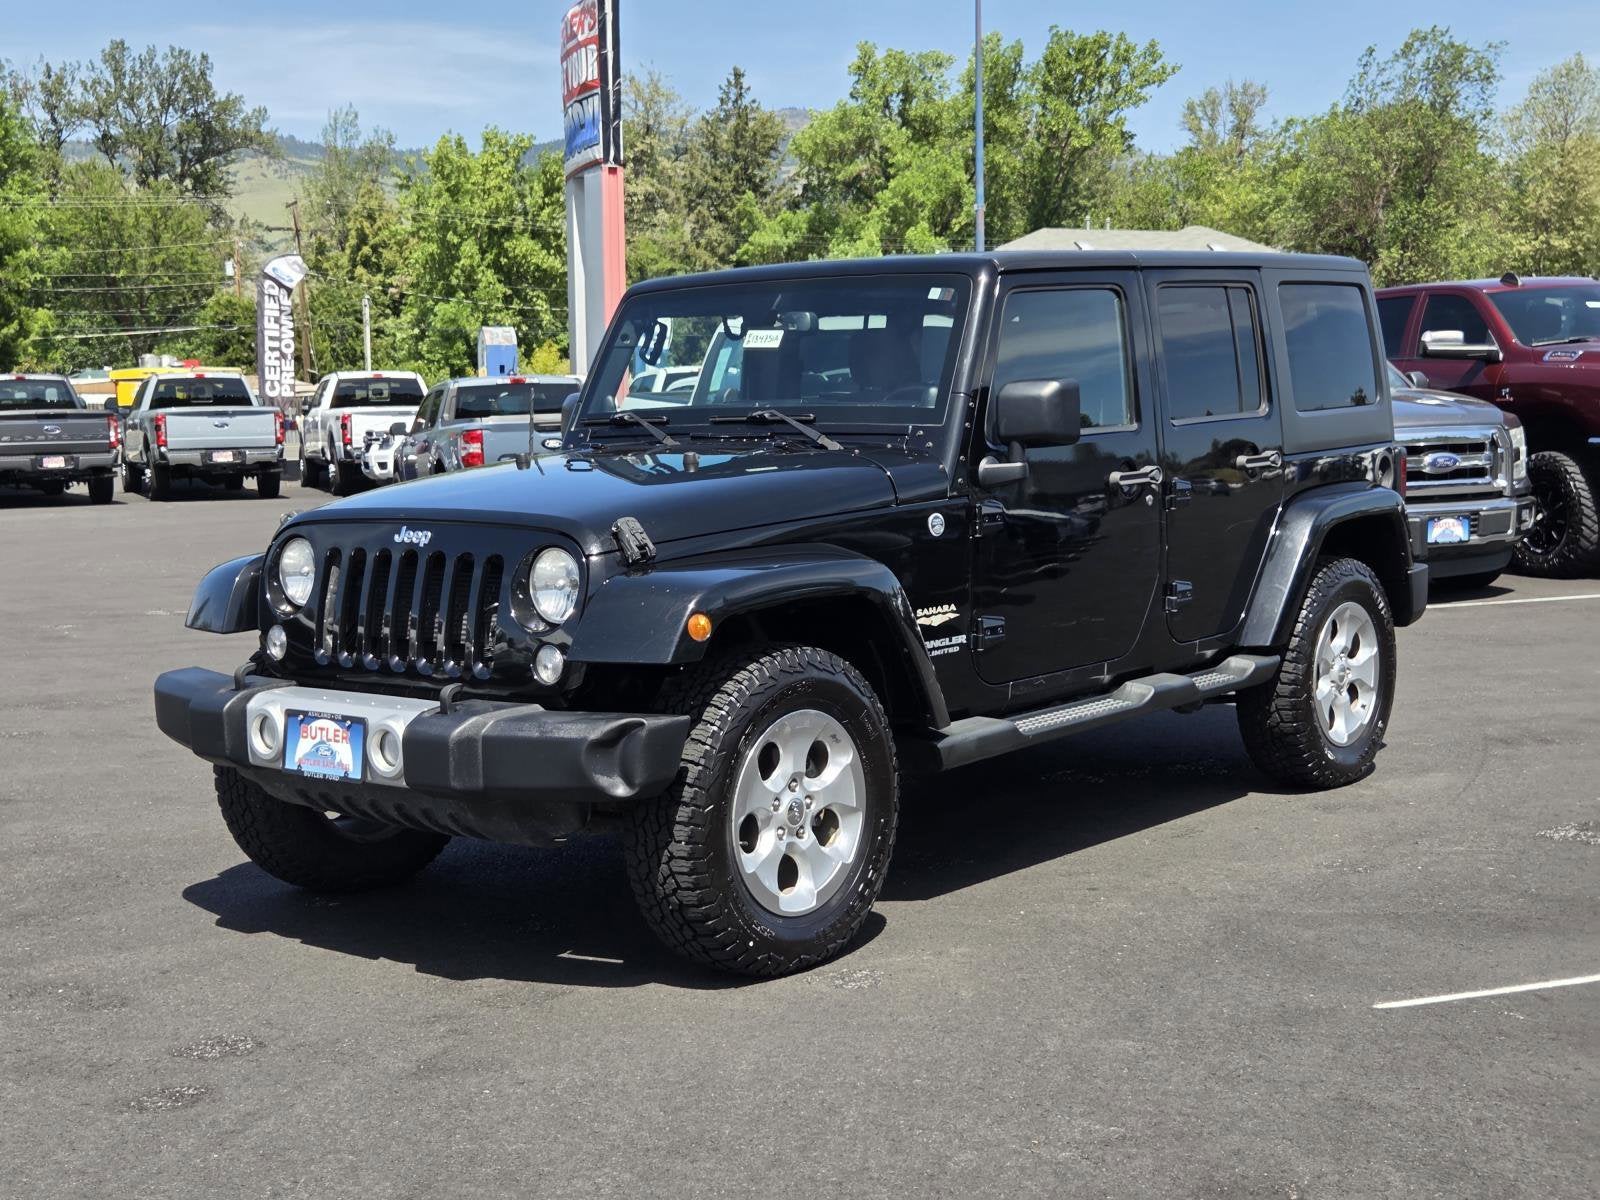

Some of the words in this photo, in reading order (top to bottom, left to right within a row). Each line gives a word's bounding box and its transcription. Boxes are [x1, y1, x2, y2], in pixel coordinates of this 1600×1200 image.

[263, 279, 281, 398] CERTIFIED
[393, 525, 432, 548] Jeep
[916, 603, 957, 617] SAHARA
[301, 724, 349, 744] BUTLER
[303, 770, 324, 779] BUTLER
